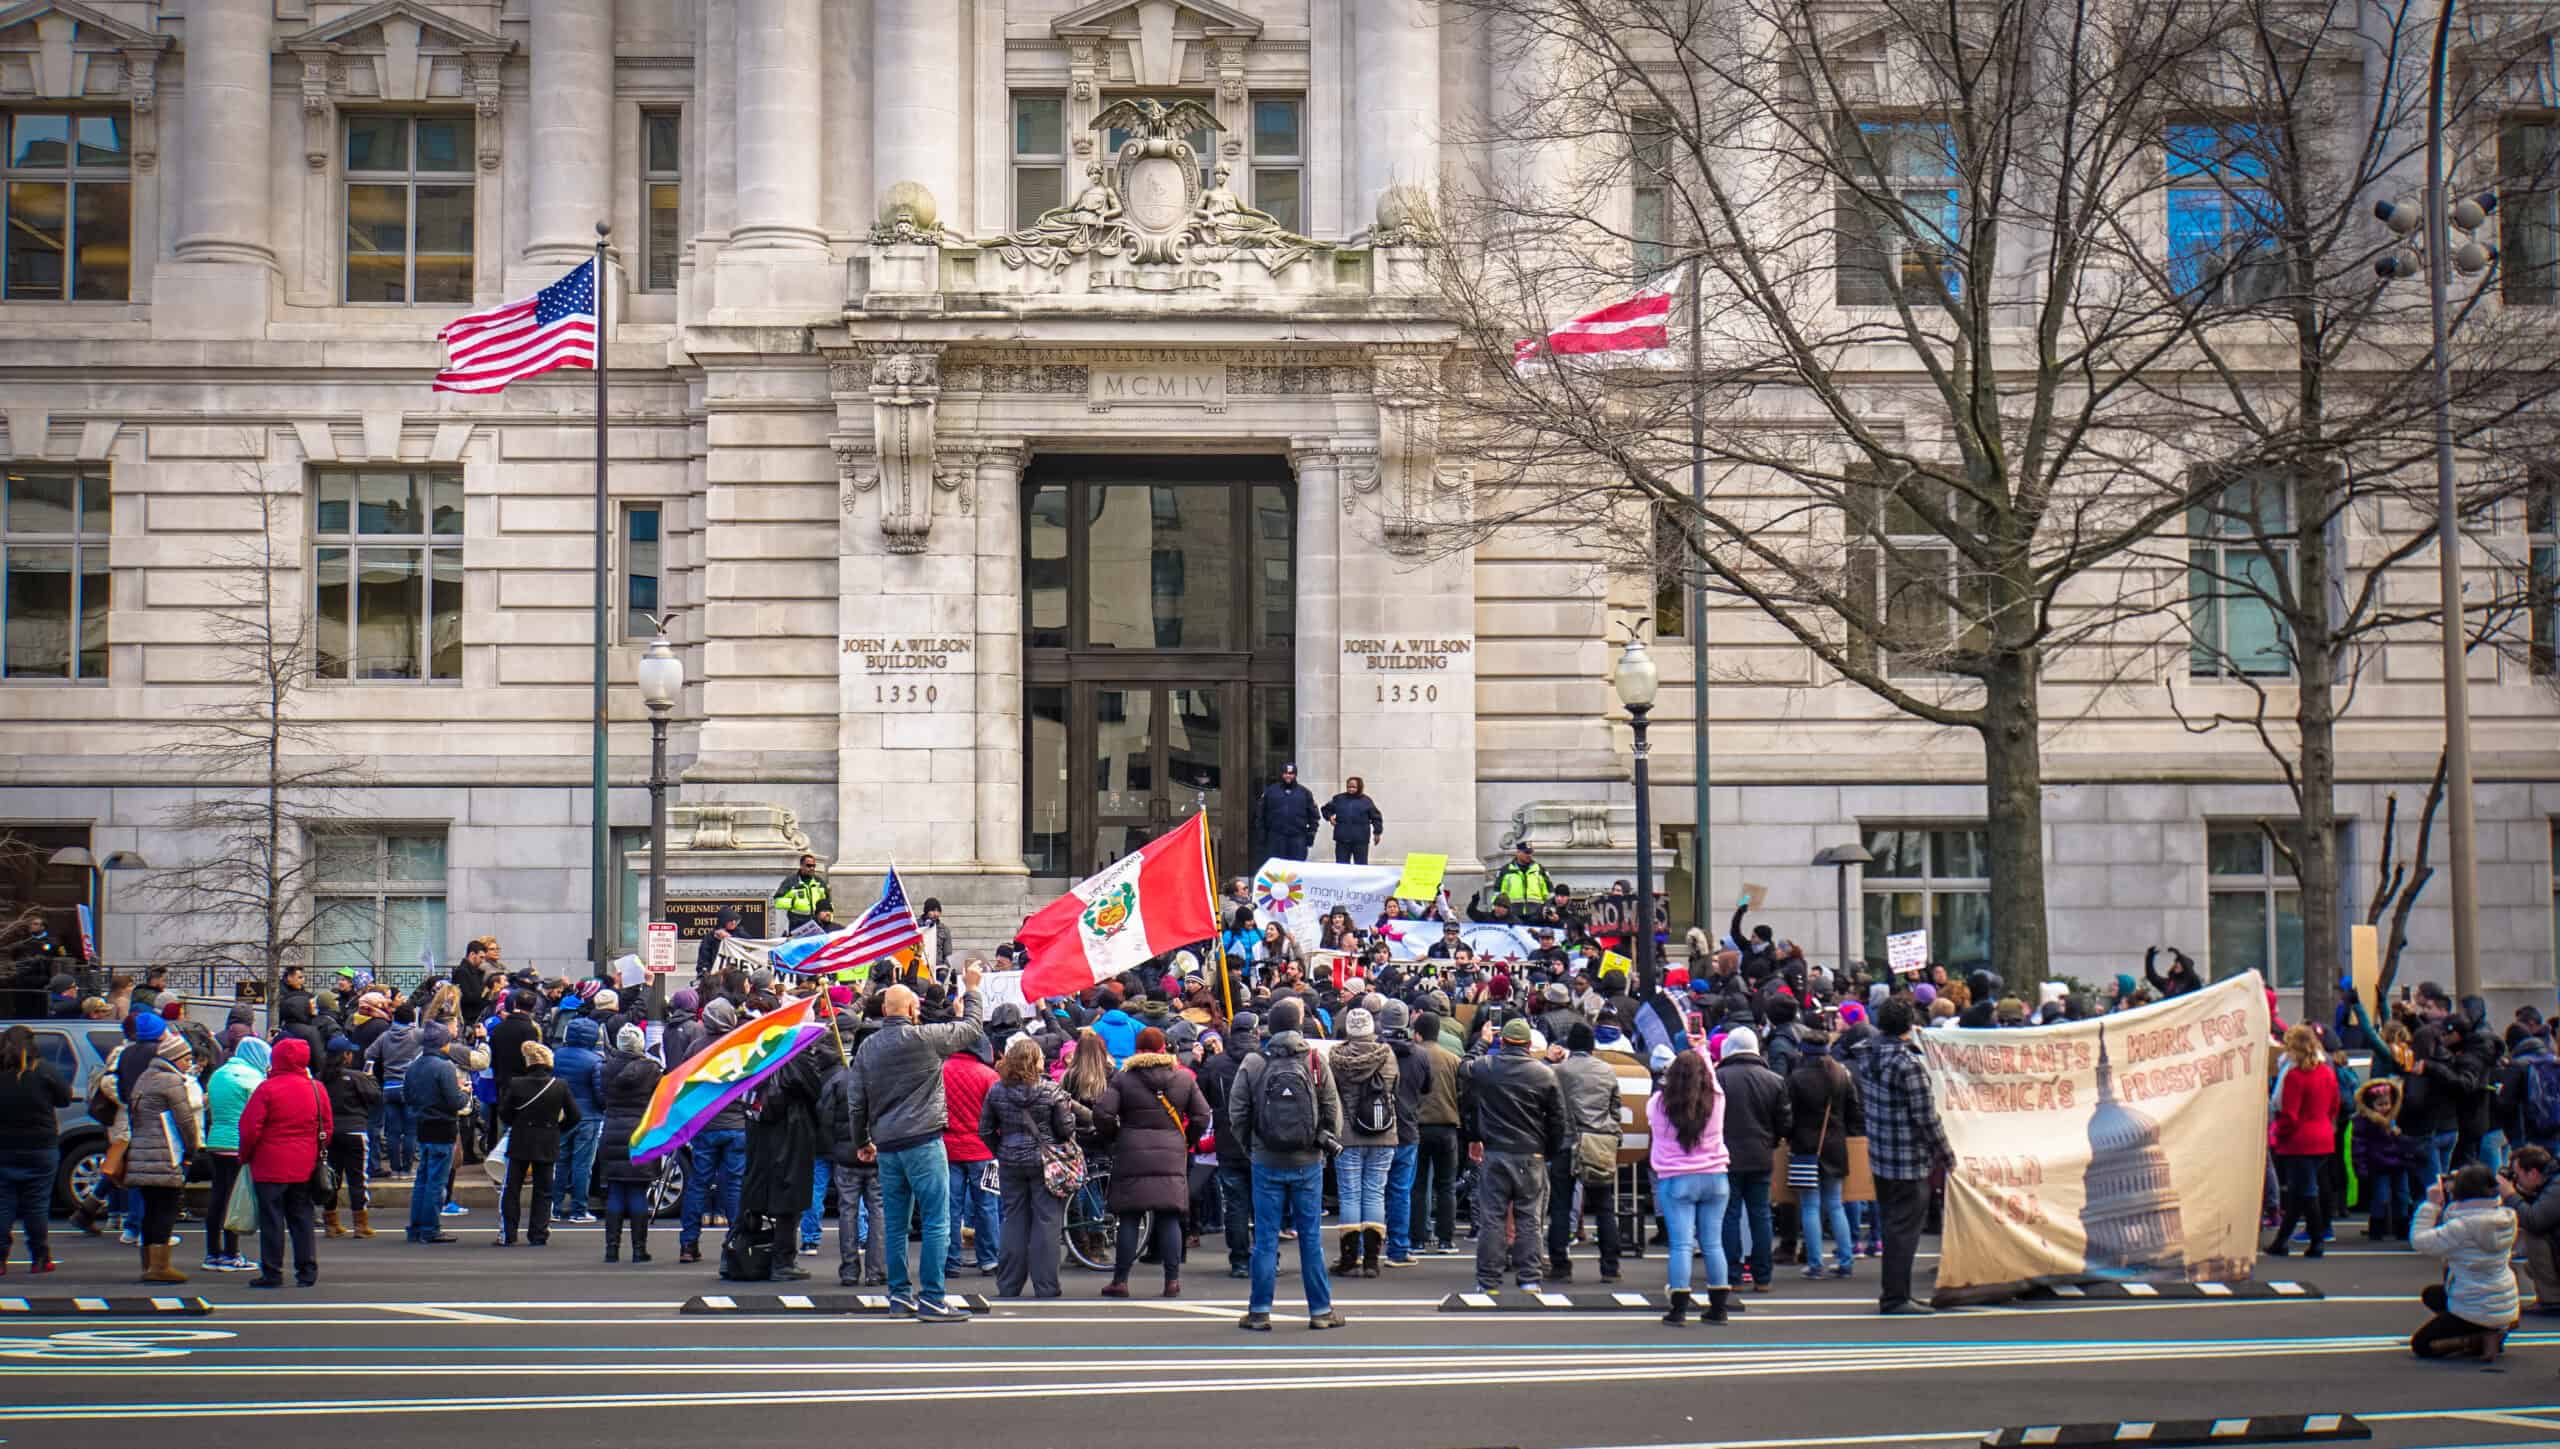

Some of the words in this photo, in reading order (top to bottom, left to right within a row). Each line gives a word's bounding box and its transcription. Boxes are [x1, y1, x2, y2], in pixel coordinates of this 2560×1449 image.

[1104, 376, 1213, 396] MCMIV
[843, 639, 885, 653] JOHN
[908, 639, 971, 653] WILSON
[1344, 639, 1386, 654] JOHN
[1408, 639, 1471, 654] WILSON
[865, 655, 948, 669] BUILDING
[1366, 655, 1449, 670] BUILDING
[875, 685, 938, 703] 1350
[1376, 684, 1438, 703] 1350
[1310, 886, 1344, 901] many
[666, 904, 728, 913] GOVERNMEN
[745, 904, 762, 913] THE
[2127, 1023, 2195, 1064] WORK
[2201, 1009, 2248, 1047] FOR
